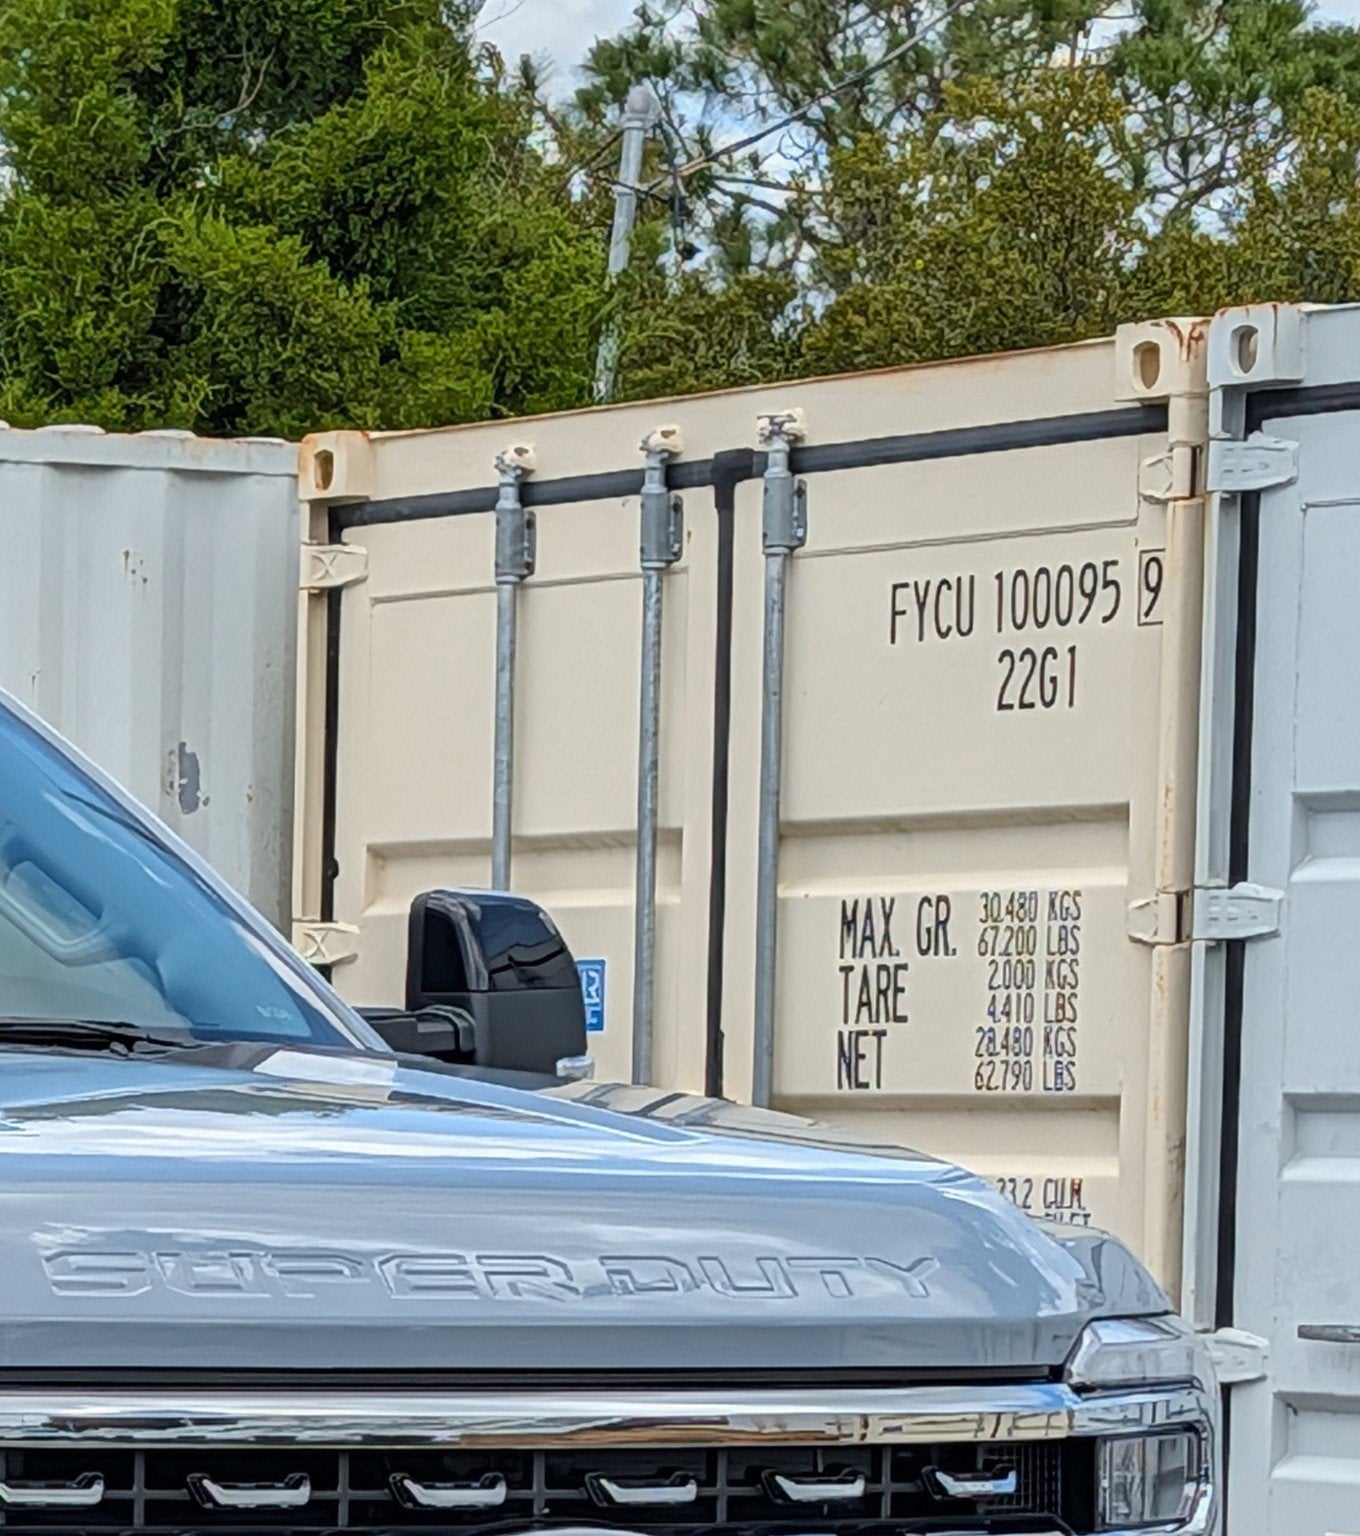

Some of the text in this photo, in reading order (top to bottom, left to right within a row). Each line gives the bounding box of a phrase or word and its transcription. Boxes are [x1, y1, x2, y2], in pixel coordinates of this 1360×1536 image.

[890, 556, 1164, 645] FYCU 100095 9
[996, 645, 1078, 711] 22G1
[1047, 889, 1082, 922] KGS
[839, 893, 957, 960] MAX. GR.
[1046, 924, 1081, 957] LBS
[838, 962, 910, 1026] TARE
[1044, 958, 1080, 990] KGS
[1044, 992, 1078, 1023] LBS
[837, 1029, 888, 1090] NET
[1043, 1026, 1077, 1058] KGS
[1042, 1060, 1076, 1091] LBS
[42, 1250, 941, 1299] SUPER DUTY
